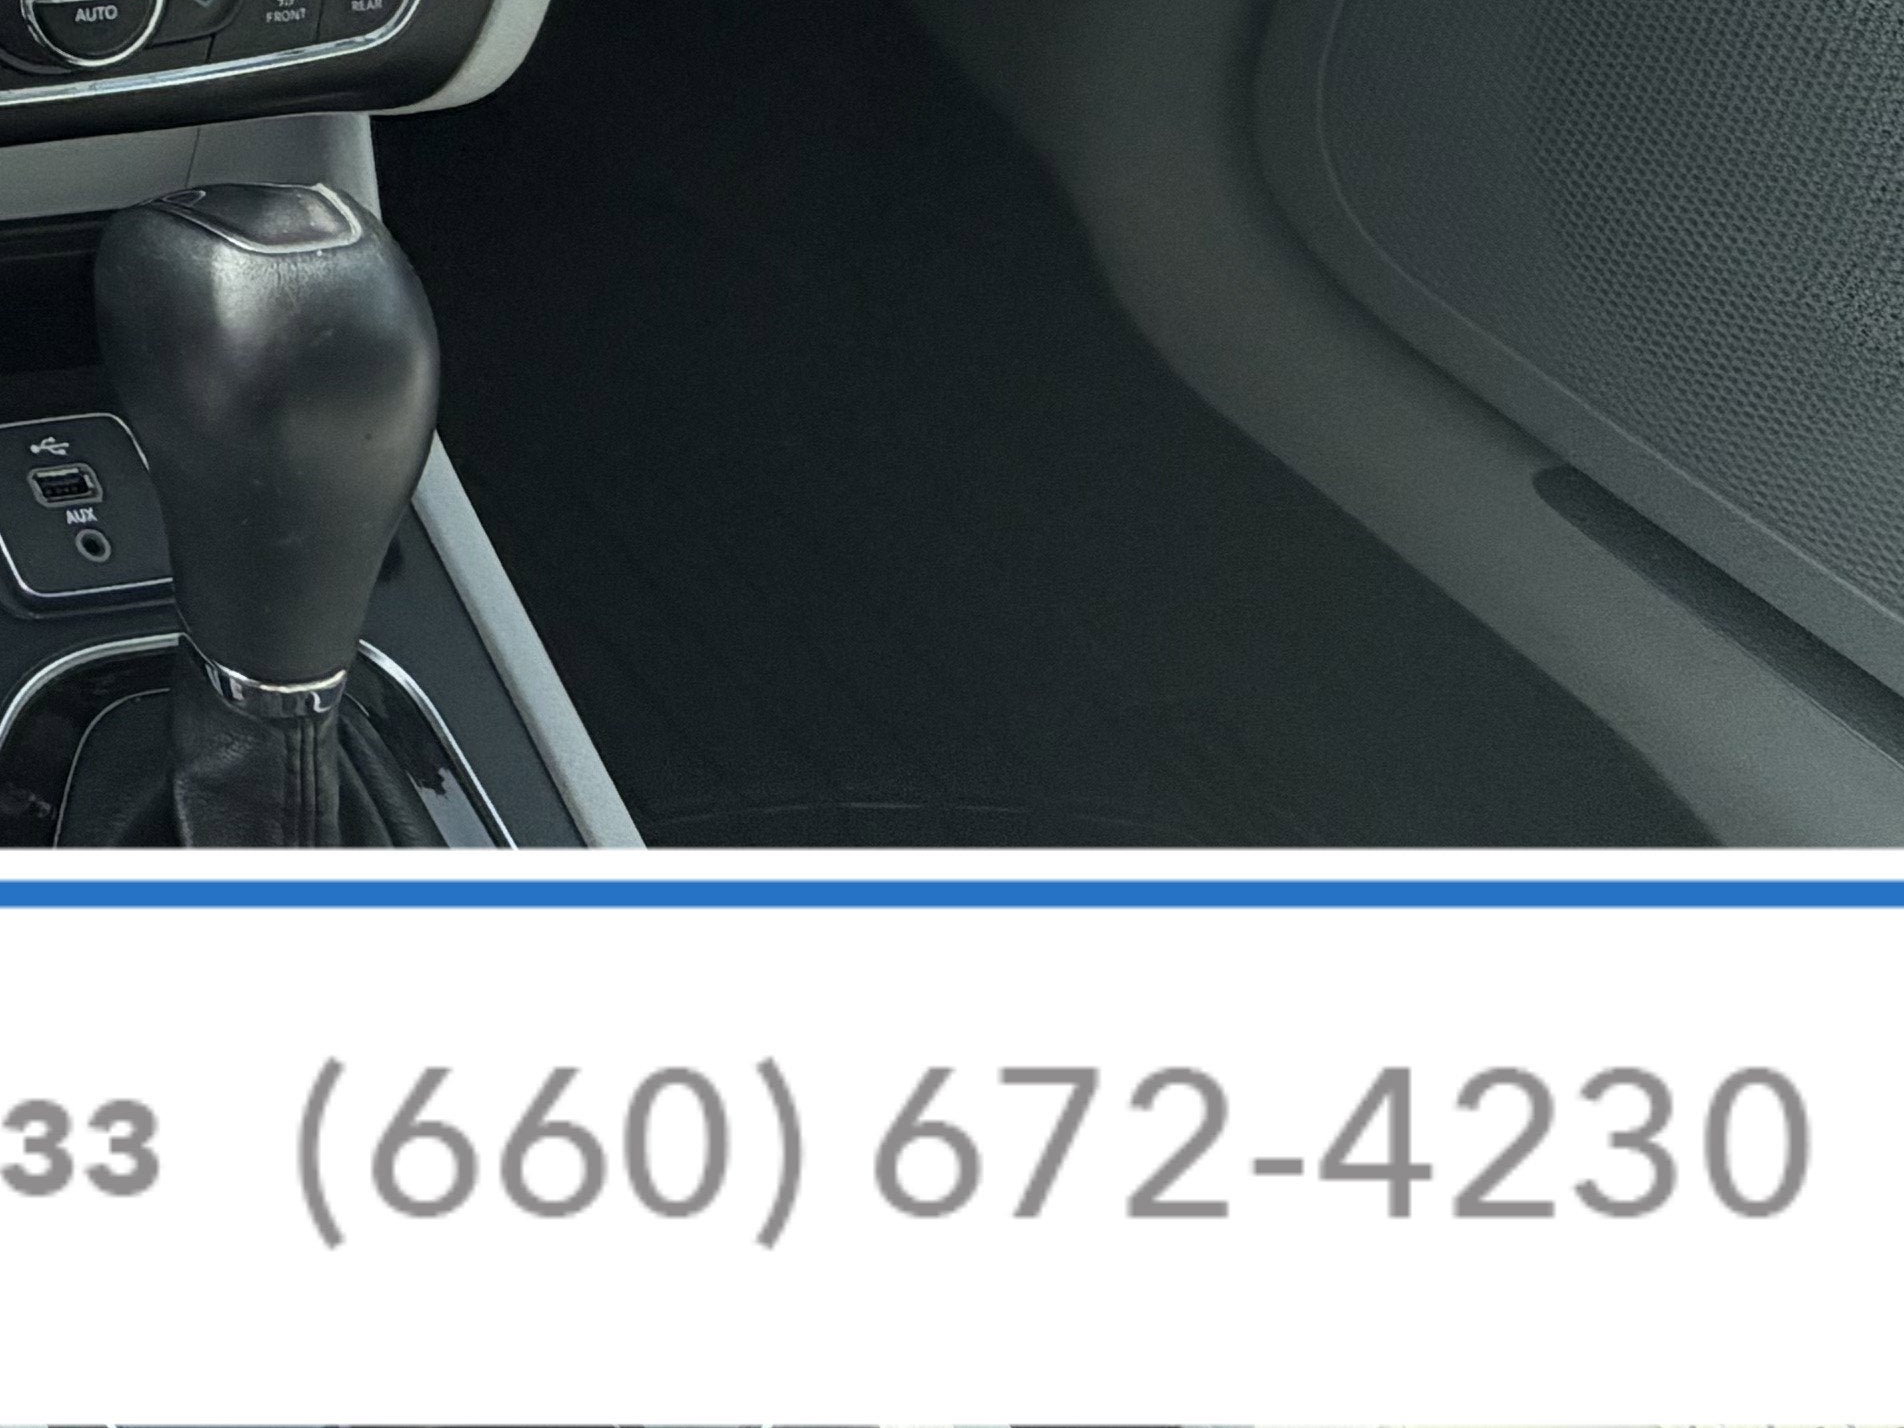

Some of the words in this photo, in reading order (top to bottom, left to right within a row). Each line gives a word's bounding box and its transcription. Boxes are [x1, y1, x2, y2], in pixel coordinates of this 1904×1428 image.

[74, 4, 119, 23] AUTO
[265, 7, 307, 23] FRONT
[65, 507, 98, 525] AUX
